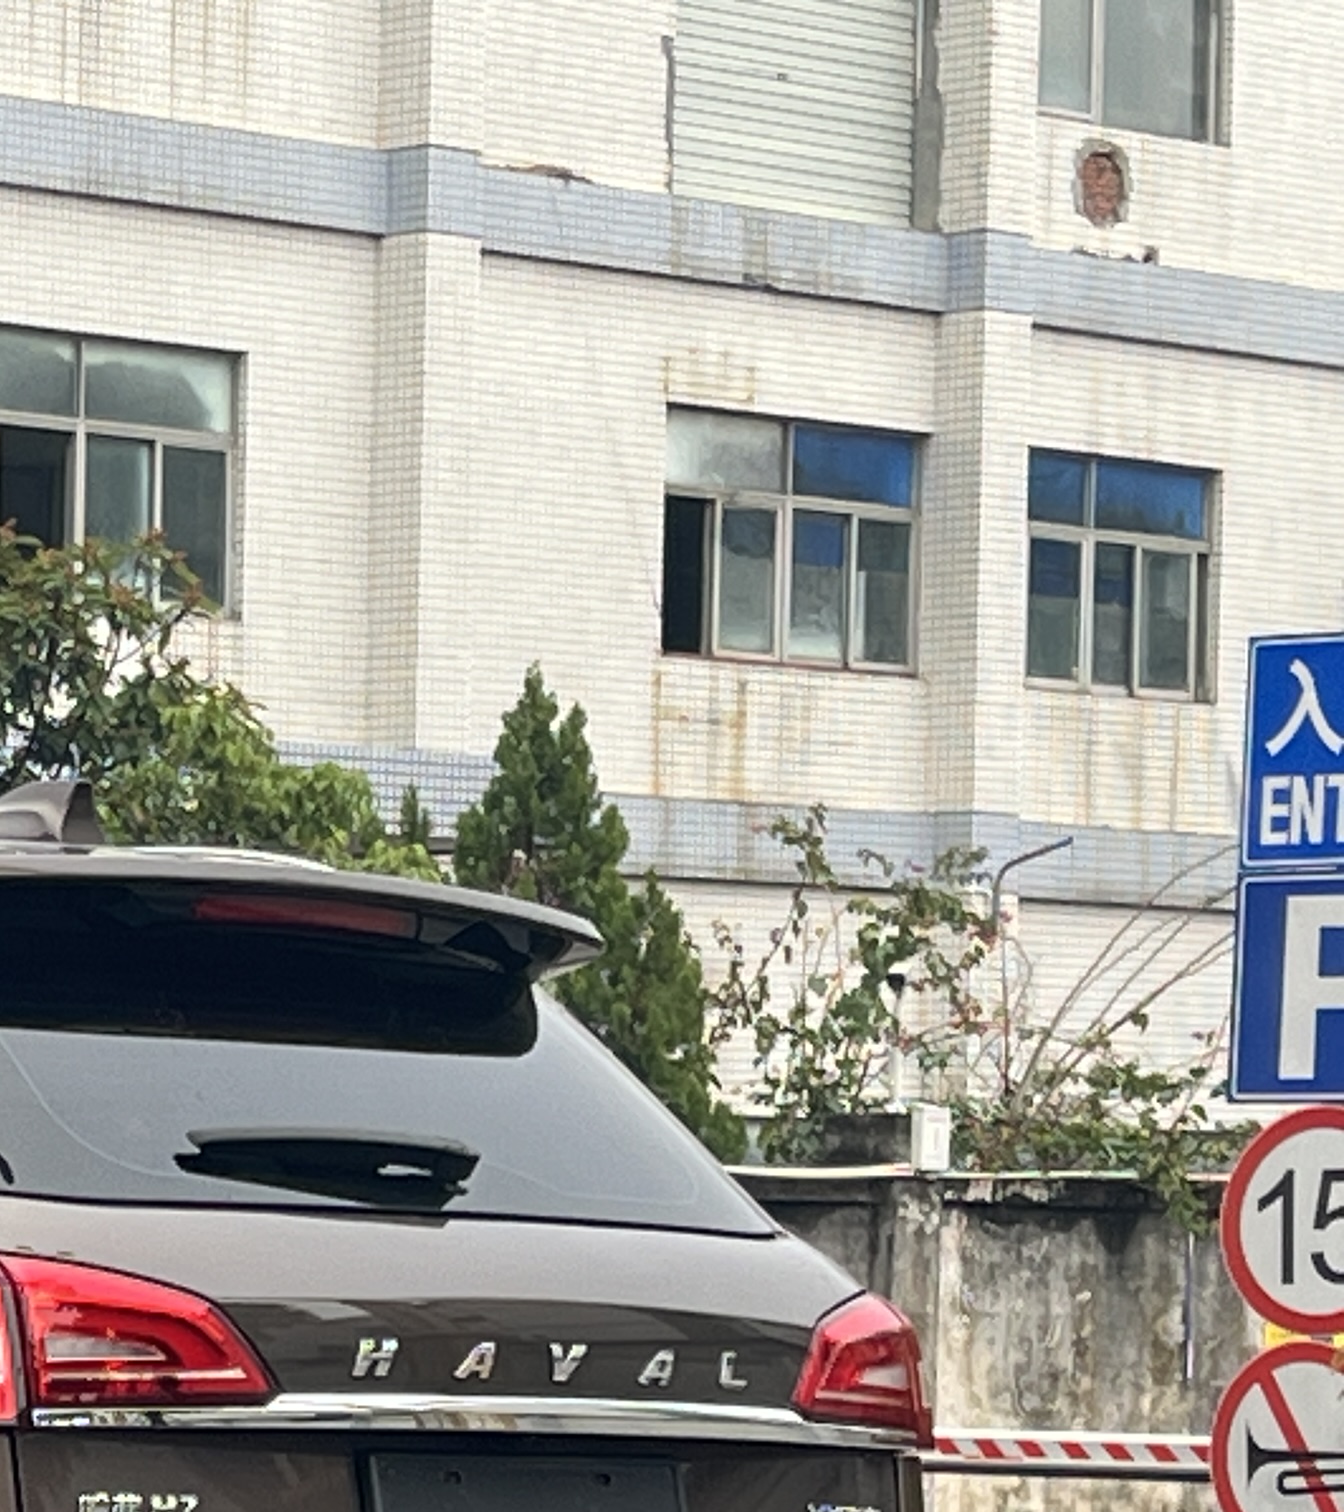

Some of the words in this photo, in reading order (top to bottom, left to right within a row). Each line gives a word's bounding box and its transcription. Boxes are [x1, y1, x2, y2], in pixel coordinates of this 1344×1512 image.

[1265, 658, 1344, 757] 入
[1257, 1169, 1344, 1285] 15
[351, 1337, 750, 1391] HAVAL
